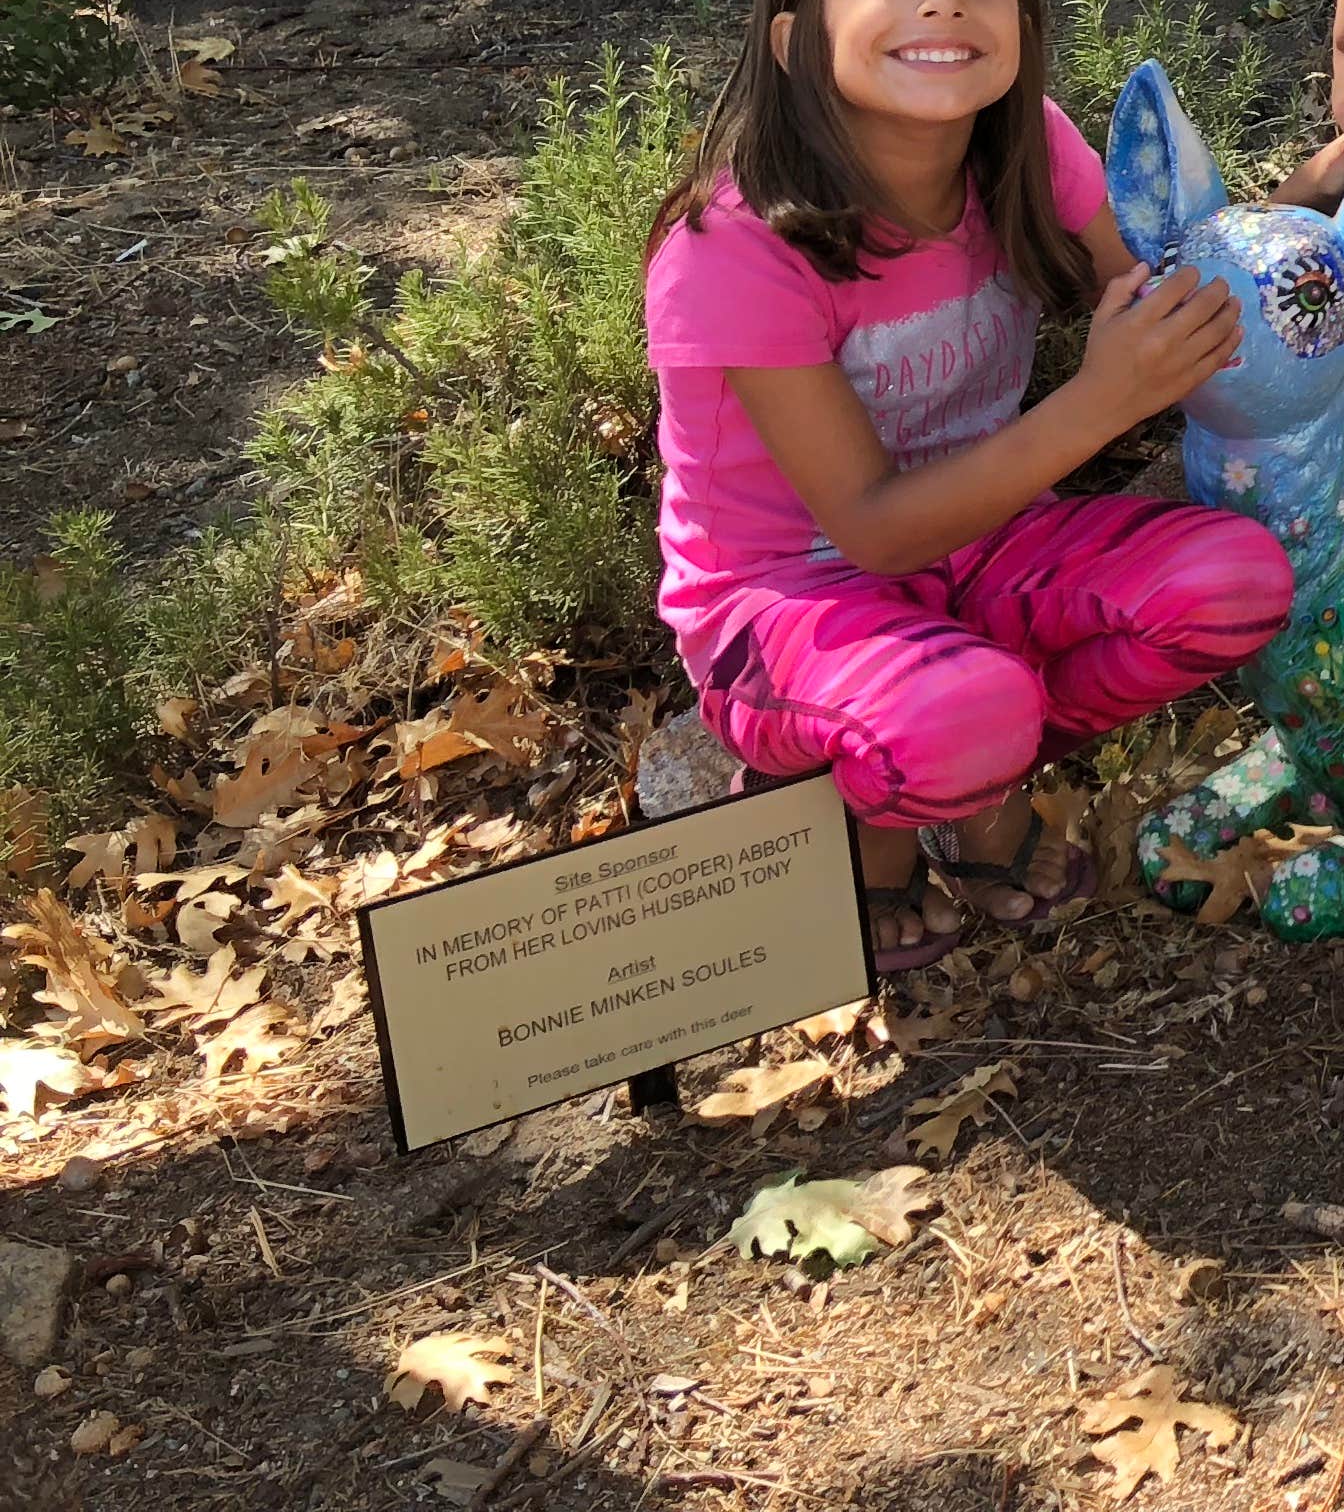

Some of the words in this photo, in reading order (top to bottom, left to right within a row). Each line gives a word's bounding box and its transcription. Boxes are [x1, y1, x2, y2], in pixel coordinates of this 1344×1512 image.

[416, 943, 437, 965] IN
[442, 913, 534, 957] MEMORY
[541, 903, 568, 925] OF
[575, 885, 631, 916] PATTI
[637, 853, 733, 900] (COOPER)
[738, 827, 812, 865] ABBOTT
[555, 870, 592, 892] Site
[598, 844, 678, 878] Sponsor
[446, 947, 508, 981] FROM
[513, 933, 556, 961] HER
[561, 907, 637, 946] LOVING
[641, 876, 736, 920] HUSBAND
[740, 857, 792, 888] TONY
[498, 1005, 584, 1048] BONNIE
[590, 976, 675, 1018] MINKEN
[682, 946, 767, 987] SOULES
[607, 955, 656, 982] Artist
[527, 1063, 580, 1088] Please
[584, 1048, 616, 1070] take
[621, 1040, 653, 1057] care
[657, 1026, 687, 1044] with
[690, 1017, 716, 1034] this
[721, 1004, 753, 1023] deer
